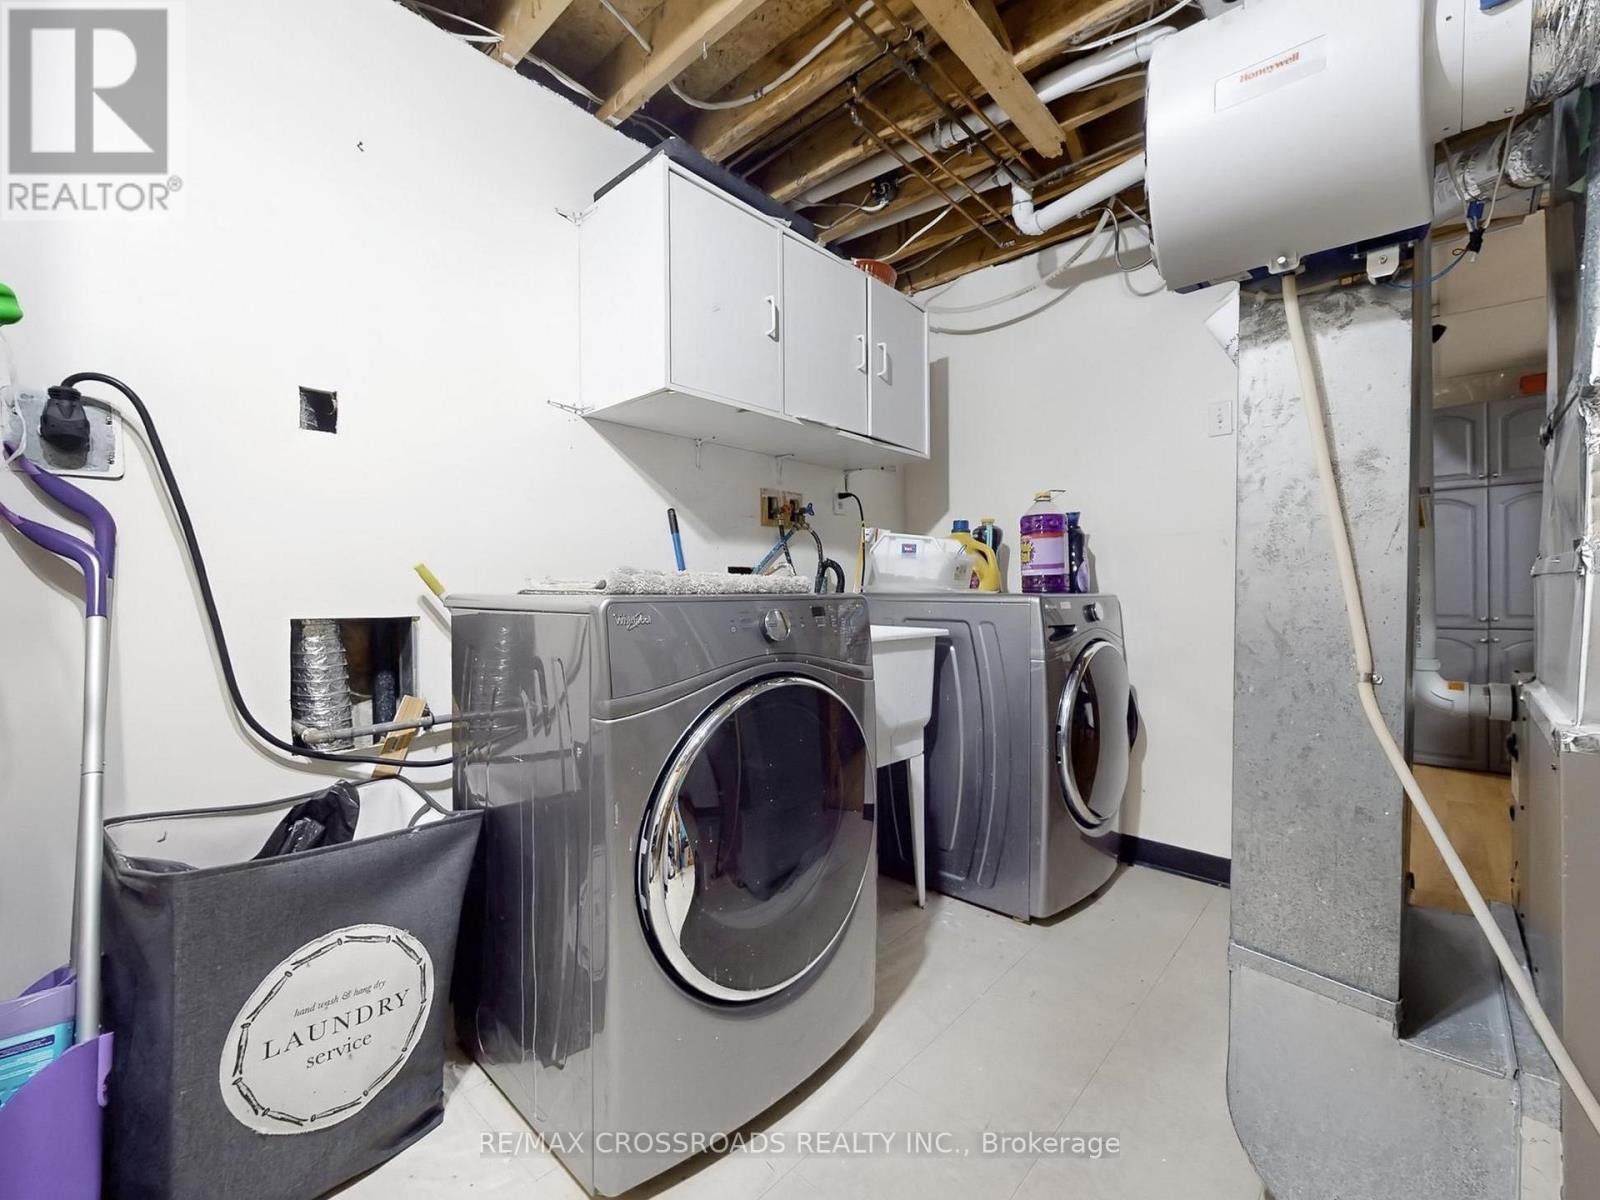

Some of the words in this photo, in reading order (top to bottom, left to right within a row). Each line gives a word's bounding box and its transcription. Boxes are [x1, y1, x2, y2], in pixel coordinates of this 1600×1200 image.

[1240, 52, 1300, 83] Honeywell
[294, 1001, 317, 1018] hand
[317, 996, 339, 1009] wash
[341, 991, 352, 1000] &
[353, 983, 372, 997] hang
[373, 978, 387, 990] dry
[262, 988, 410, 1061] LAUNDRY
[306, 1033, 372, 1069] service
